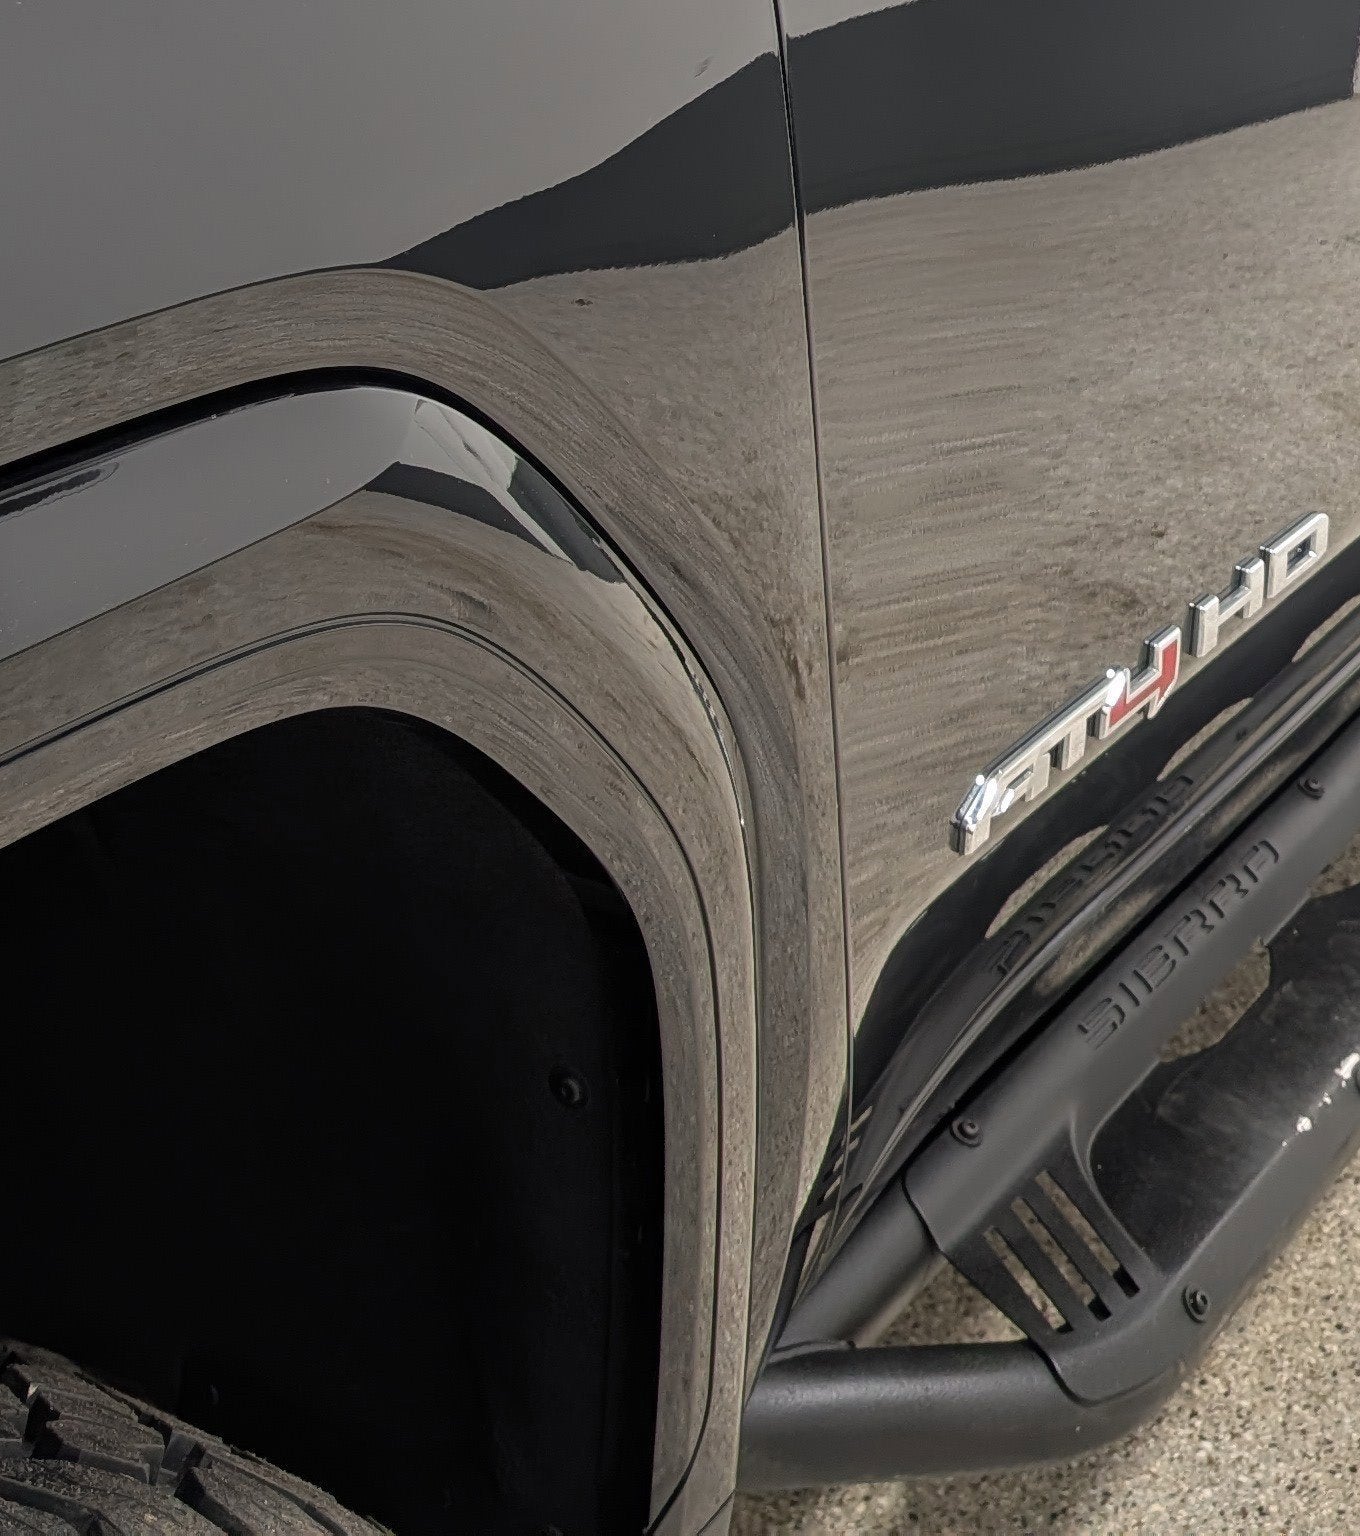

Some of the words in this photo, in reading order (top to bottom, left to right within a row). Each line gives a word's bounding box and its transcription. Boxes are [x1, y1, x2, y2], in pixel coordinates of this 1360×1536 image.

[949, 624, 1182, 855] AT4
[1187, 511, 1329, 659] HD
[1077, 839, 1280, 1052] SIERRA
